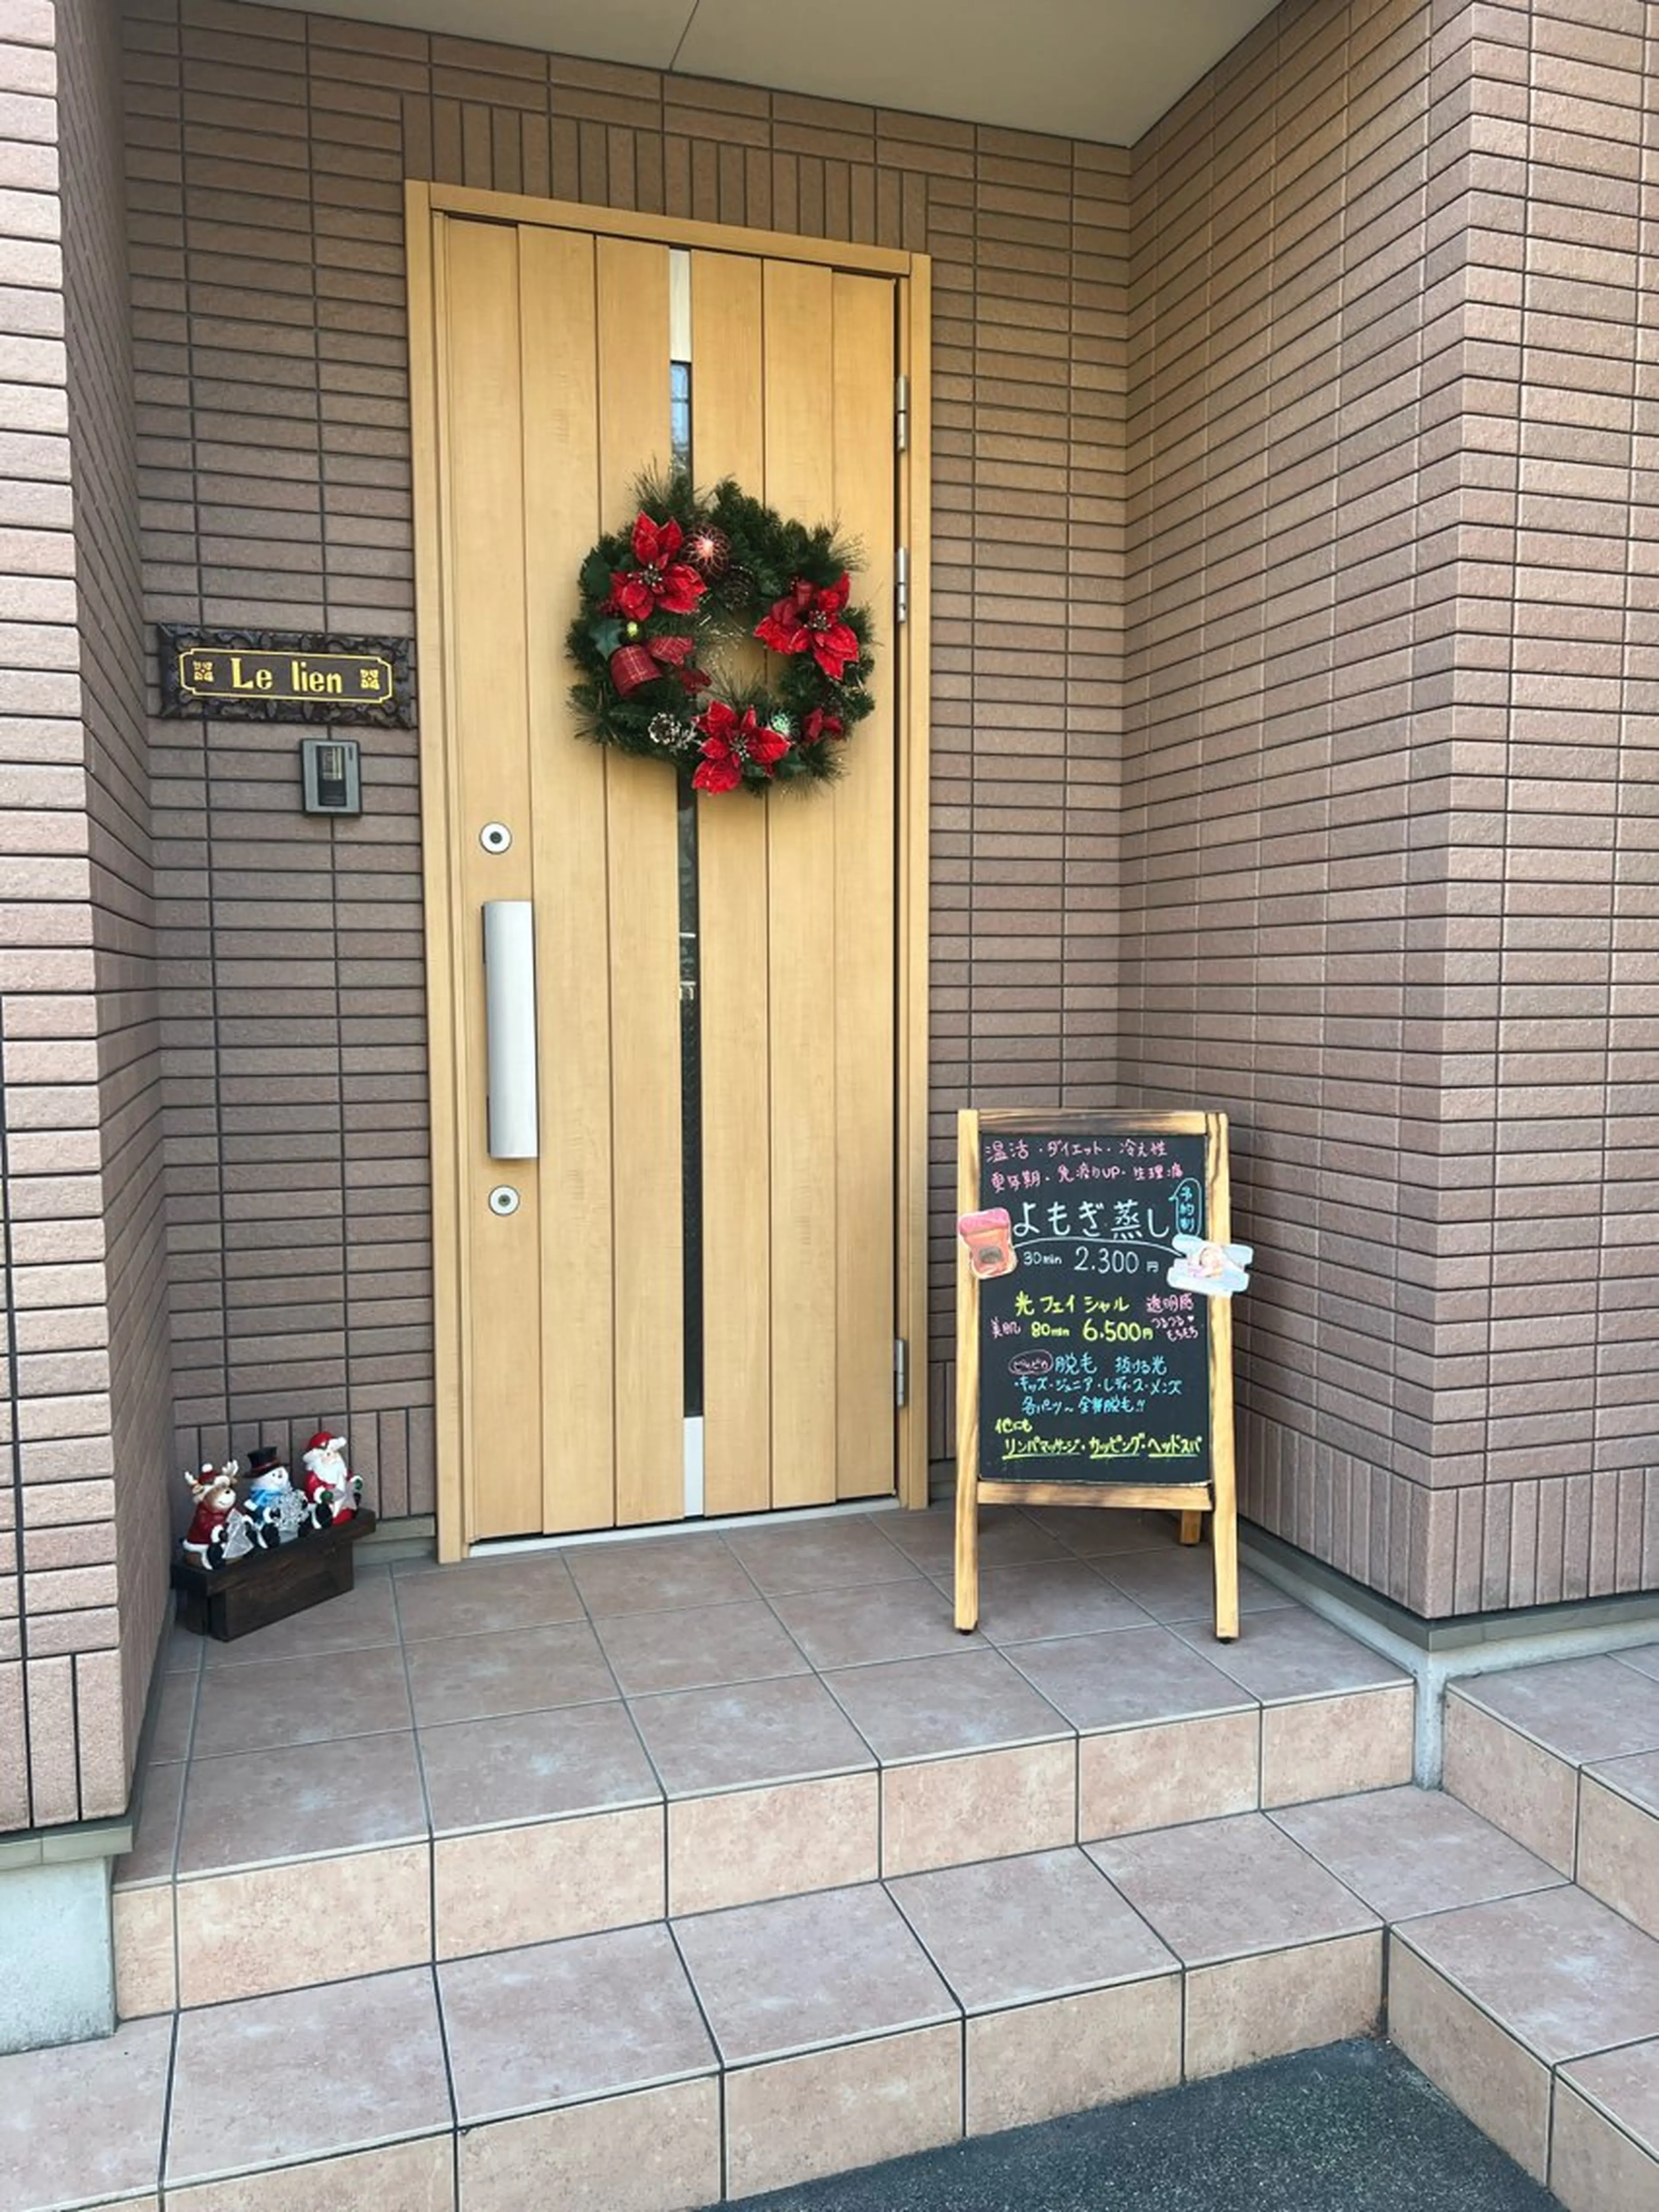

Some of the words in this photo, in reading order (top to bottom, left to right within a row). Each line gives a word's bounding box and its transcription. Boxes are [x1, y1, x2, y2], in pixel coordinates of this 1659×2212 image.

[230, 658, 273, 690] Le
[291, 661, 343, 693] lien
[1013, 1198, 1169, 1240] よもぎ蒸し
[1023, 1251, 1062, 1266] 30min
[990, 1316, 1021, 1338] 美肌
[1031, 1321, 1070, 1338] 80min
[1055, 1351, 1097, 1375] 脱毛
[995, 1417, 1033, 1434] 他にも
